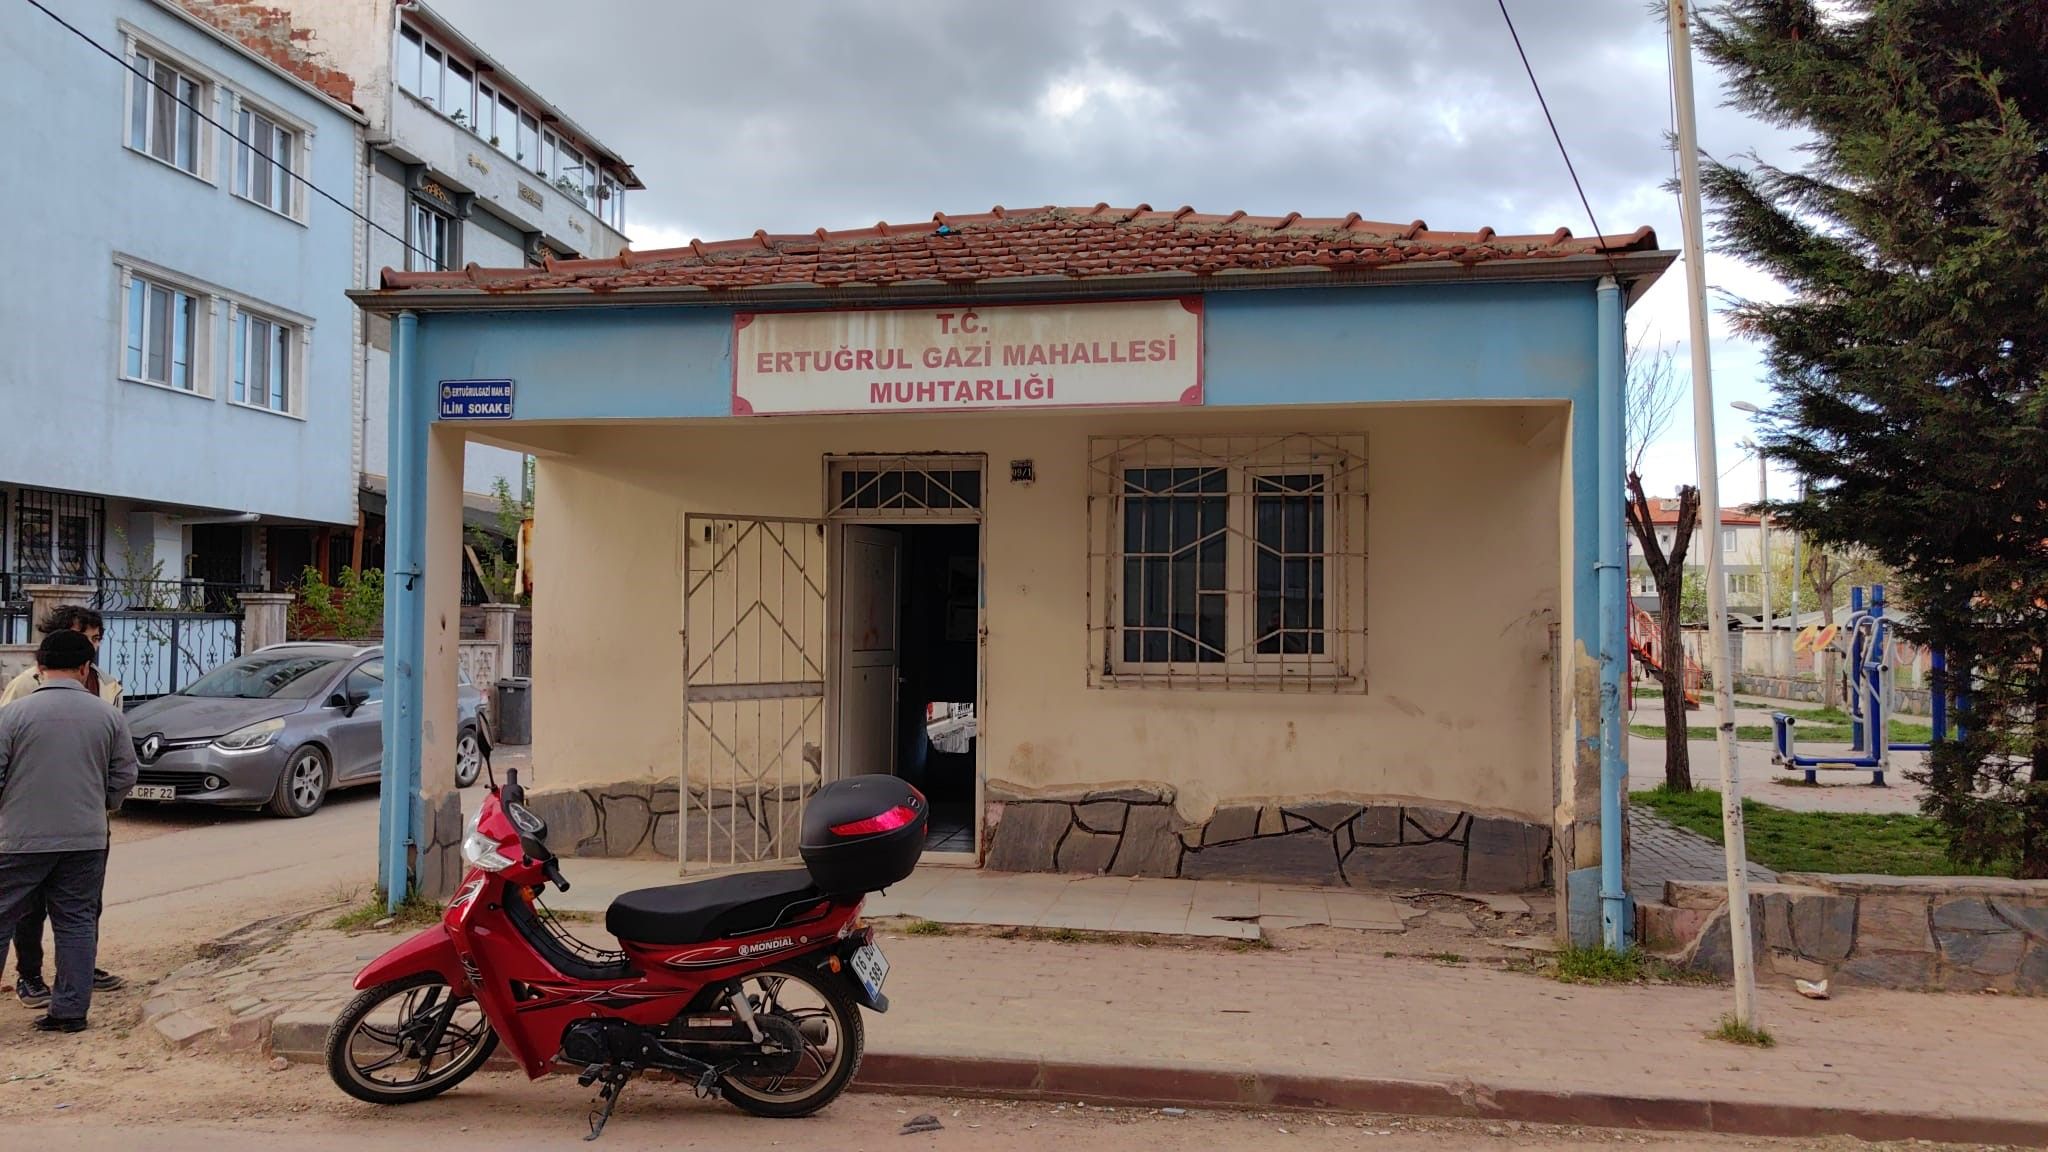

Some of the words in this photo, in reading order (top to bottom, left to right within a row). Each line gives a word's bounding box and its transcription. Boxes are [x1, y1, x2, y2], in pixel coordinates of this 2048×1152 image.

[936, 311, 988, 334] T.C.
[757, 345, 912, 373] ERTUĞRUL
[922, 340, 992, 369] GAZİ
[1003, 334, 1176, 366] MAHALLESİ
[452, 385, 490, 396] ERTUĞRULGAZİ
[870, 372, 1054, 403] MUHTARLIĞI
[443, 401, 463, 414] İLİM
[468, 403, 502, 414] SOKAK
[138, 787, 155, 797] CRF
[160, 788, 172, 798] 22
[749, 938, 794, 953] MONDIAL
[855, 955, 867, 974] 16
[869, 961, 882, 986] 589
